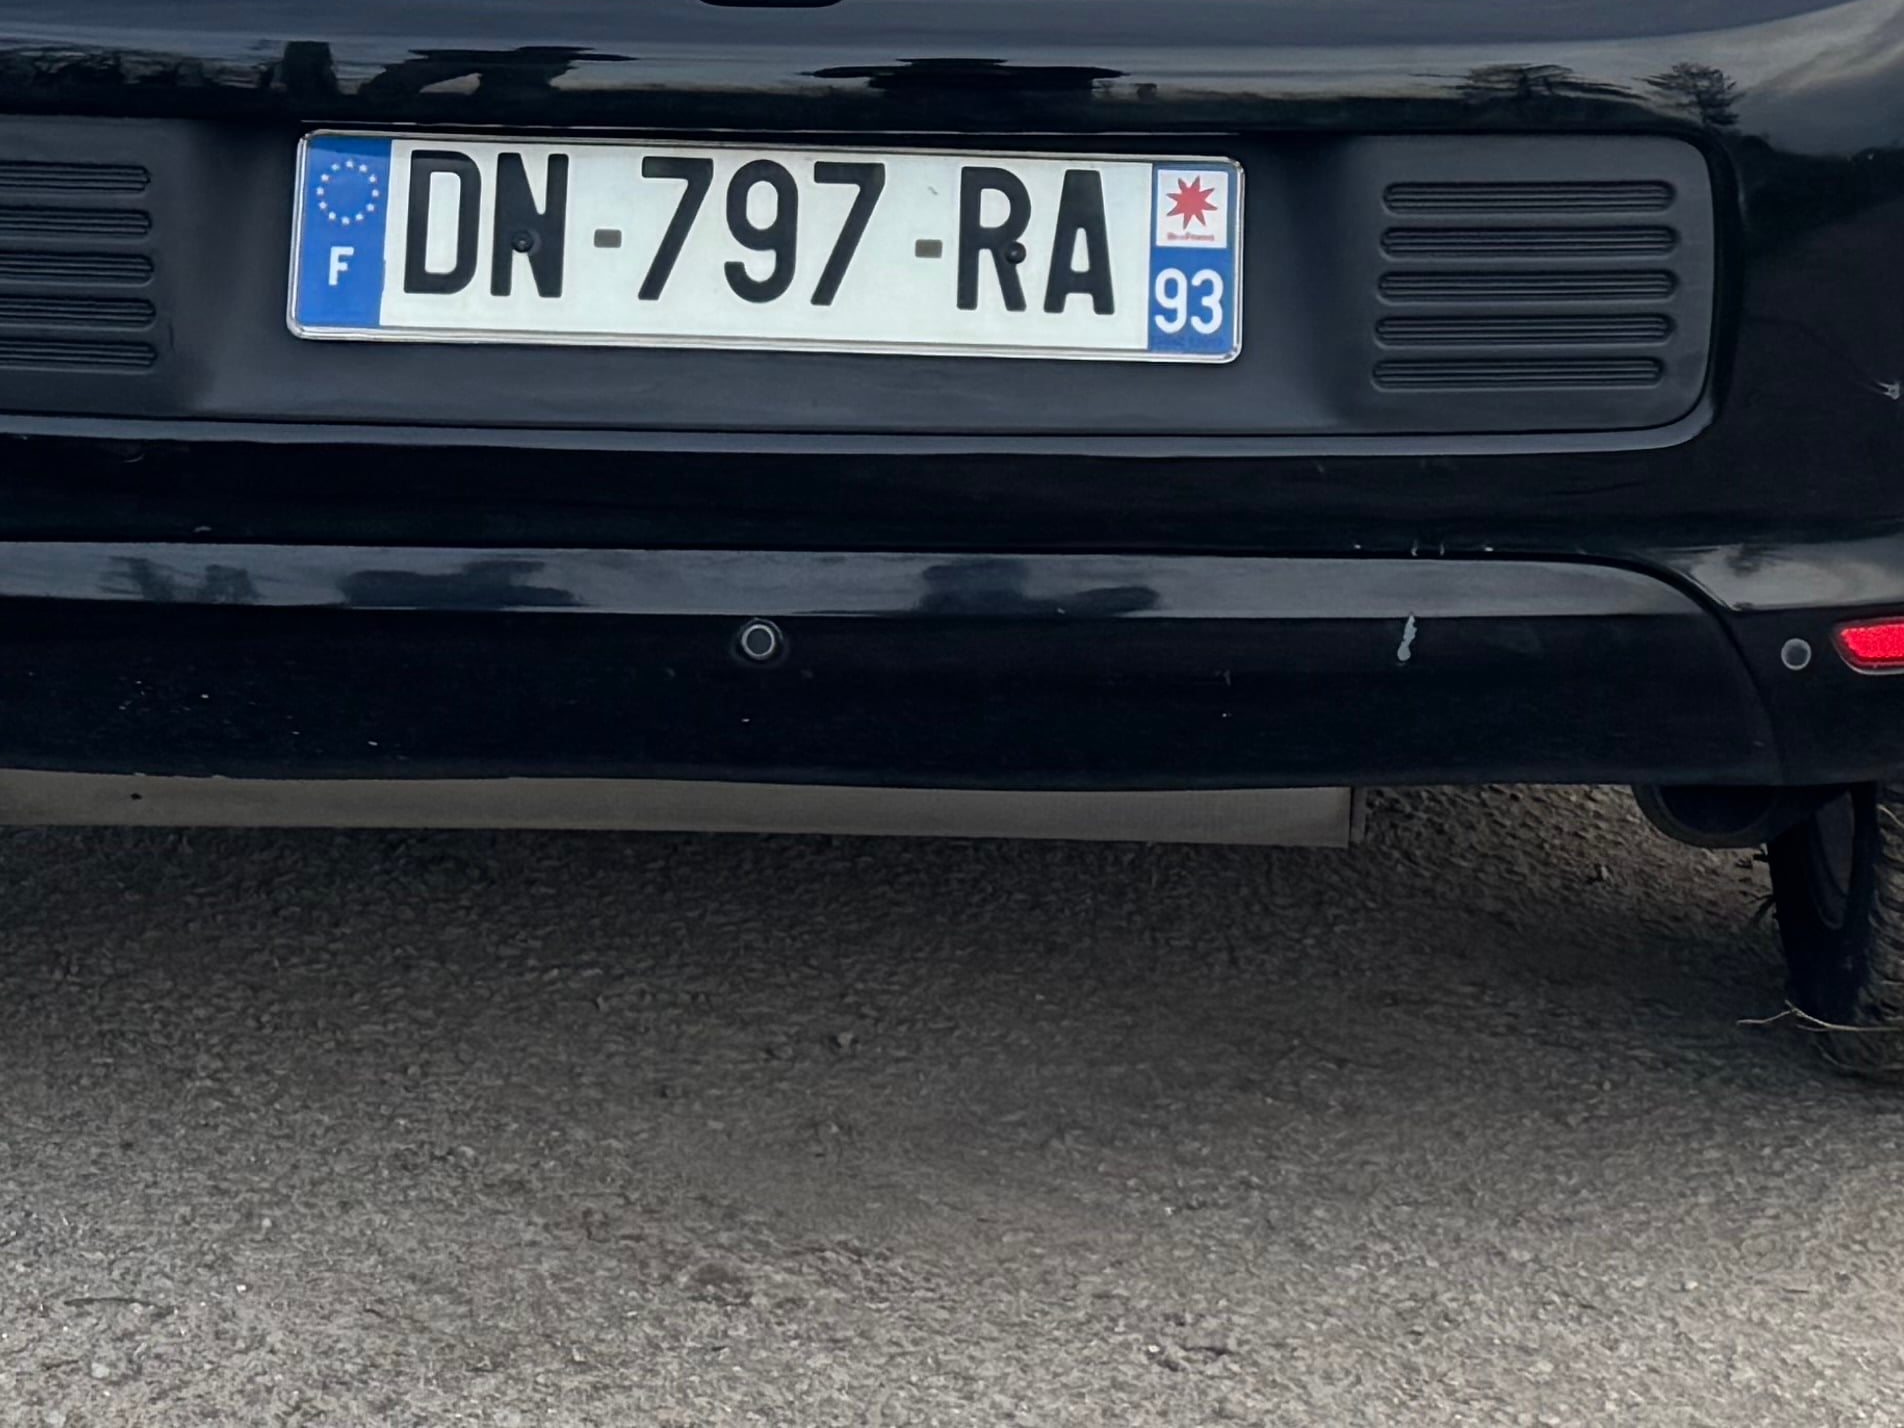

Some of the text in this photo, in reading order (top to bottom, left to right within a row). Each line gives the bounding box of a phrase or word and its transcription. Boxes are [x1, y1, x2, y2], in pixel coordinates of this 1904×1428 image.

[328, 246, 355, 286] F
[403, 149, 1116, 315] DN-797-RA
[1154, 267, 1225, 335] 93
